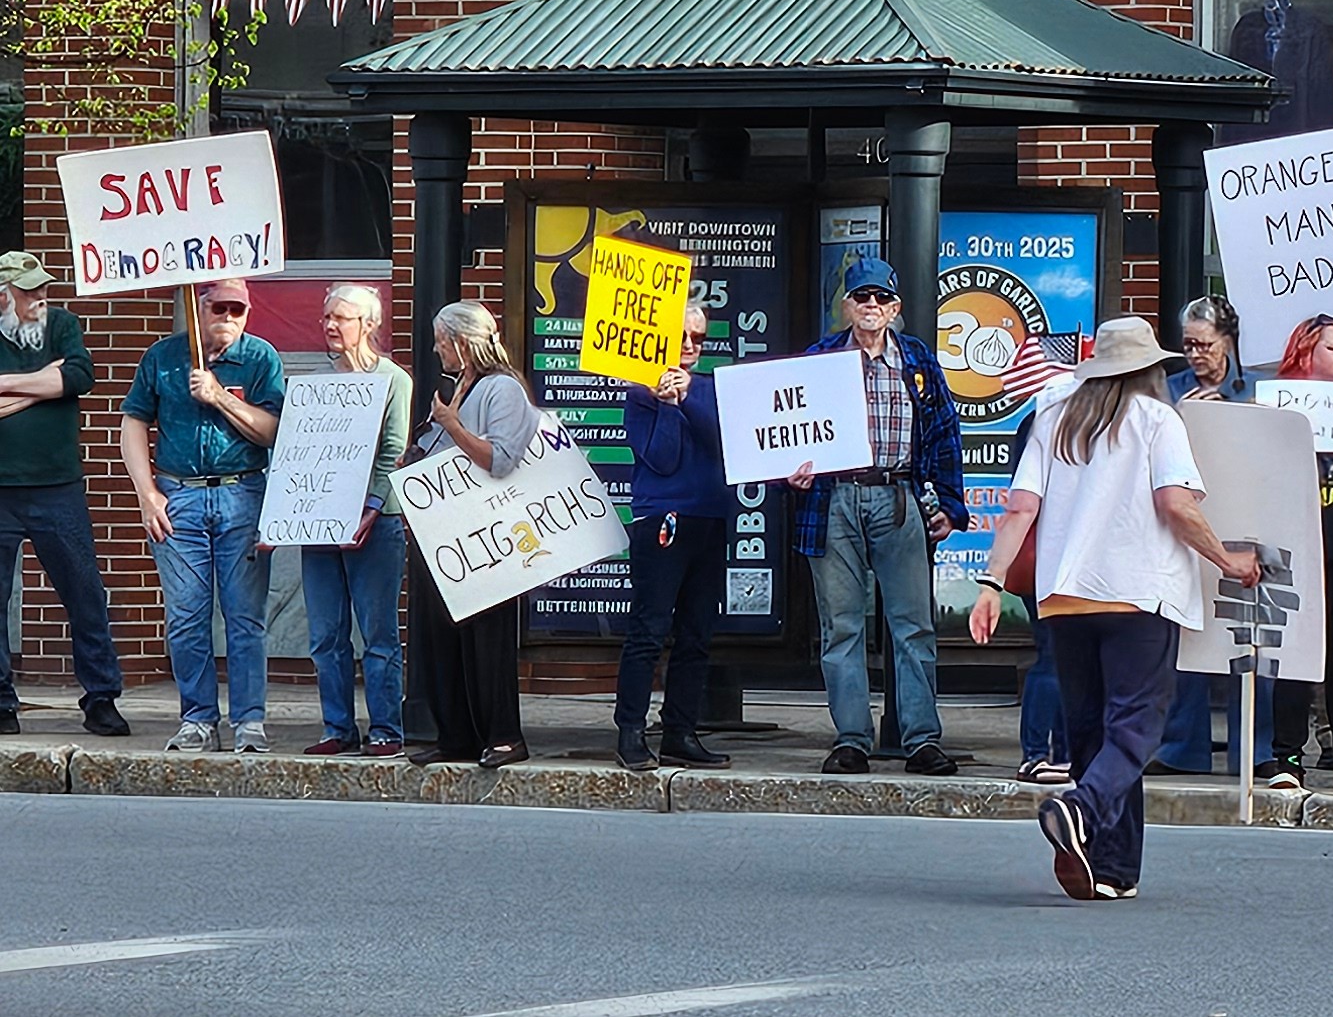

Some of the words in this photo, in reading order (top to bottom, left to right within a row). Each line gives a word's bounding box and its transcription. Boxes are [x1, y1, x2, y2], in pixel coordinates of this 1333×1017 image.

[100, 164, 224, 221] SAVE
[688, 222, 776, 236] DOWNTOWN
[967, 236, 1014, 258] 30TH
[1019, 236, 1075, 258] 2025
[593, 248, 646, 286] HANDS
[652, 261, 686, 294] OFF
[976, 270, 999, 289] OF
[612, 287, 662, 328] FREE
[592, 319, 668, 366] SPEECH
[290, 382, 374, 408] CONGRESS
[773, 386, 807, 413] AVE
[755, 420, 835, 452] VERITAS
[285, 471, 337, 495] SAVE
[485, 483, 525, 511] THE
[266, 518, 352, 542] COUNTRY
